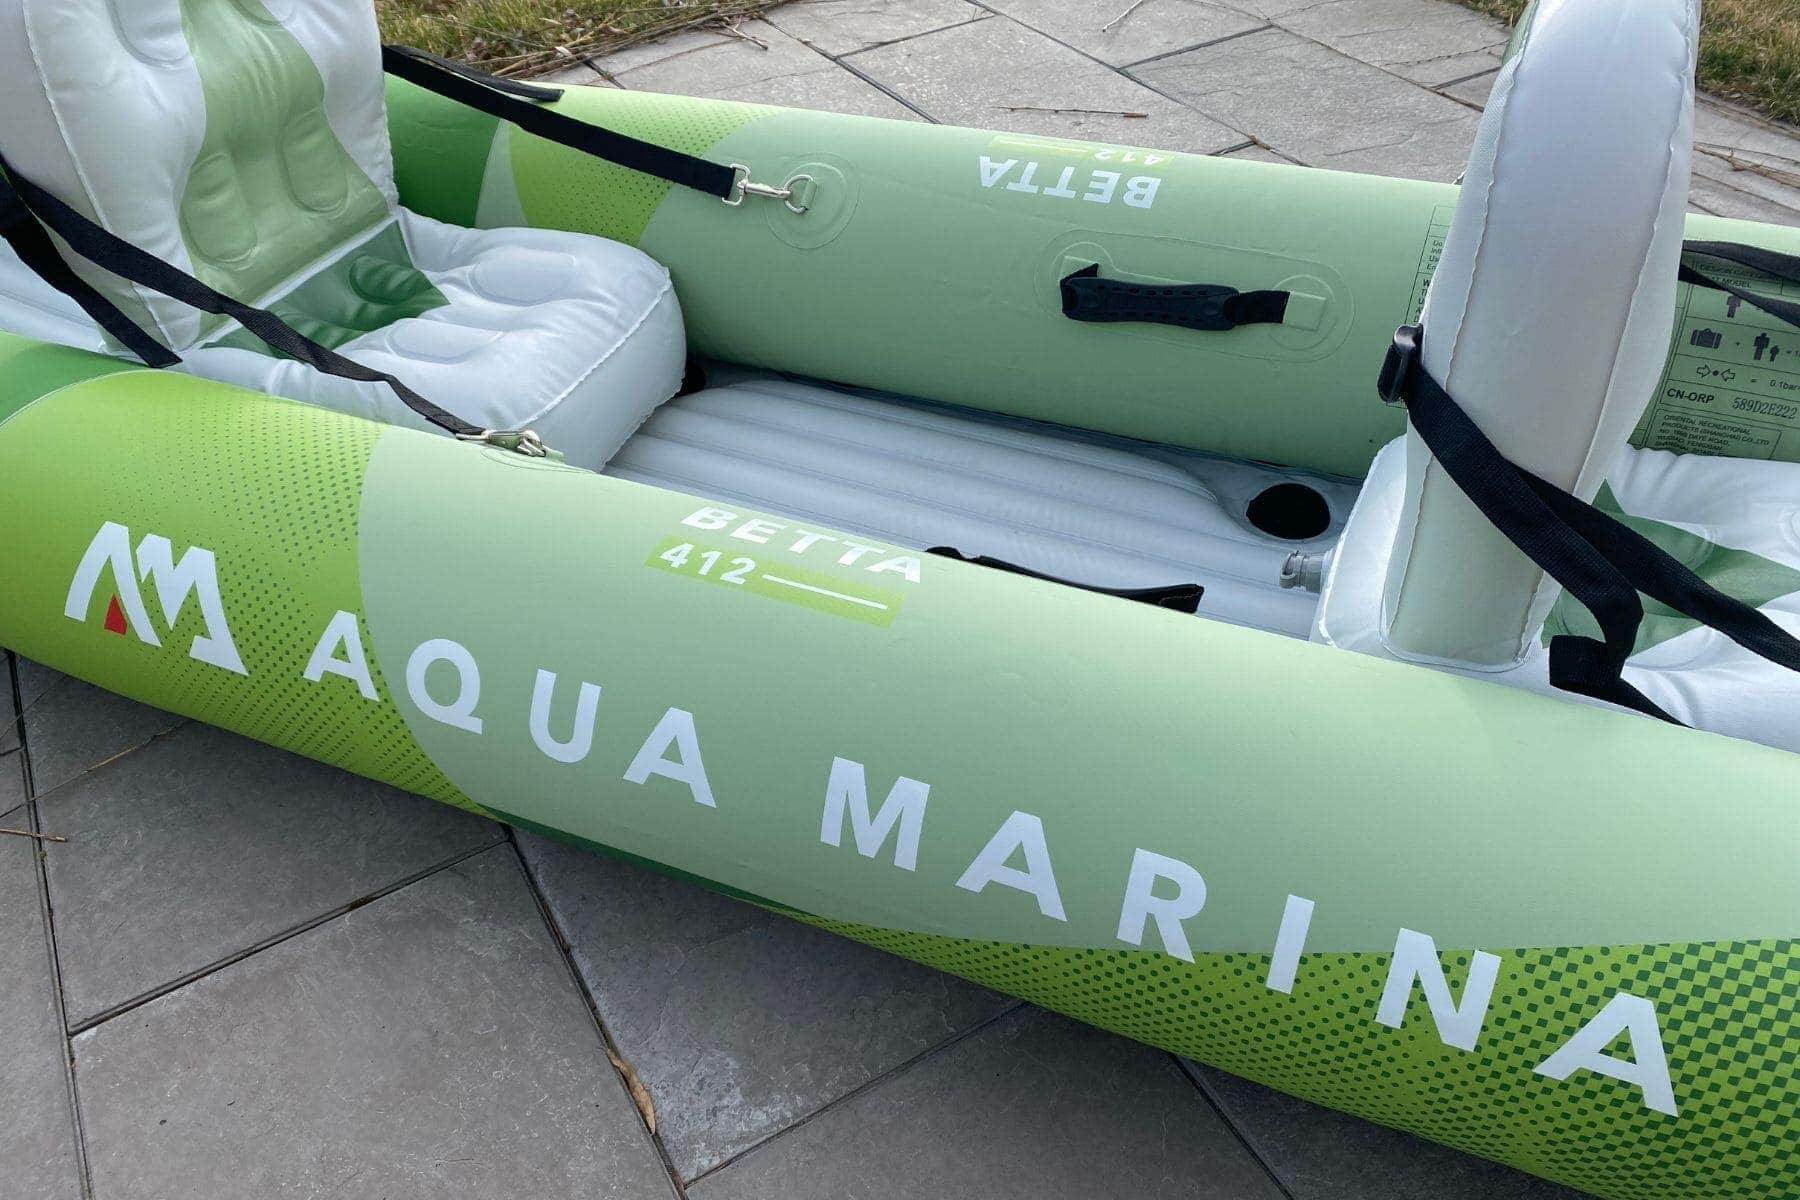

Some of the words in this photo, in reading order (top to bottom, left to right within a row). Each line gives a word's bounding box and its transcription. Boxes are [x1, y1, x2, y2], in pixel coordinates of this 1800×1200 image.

[1093, 148, 1167, 166] 412
[978, 154, 1163, 210] BETTA
[1666, 388, 1715, 404] CN-ORP
[659, 542, 756, 585] 412
[680, 506, 921, 584] BETTA
[303, 610, 717, 809] AQUA
[820, 756, 1679, 1118] MARINA
